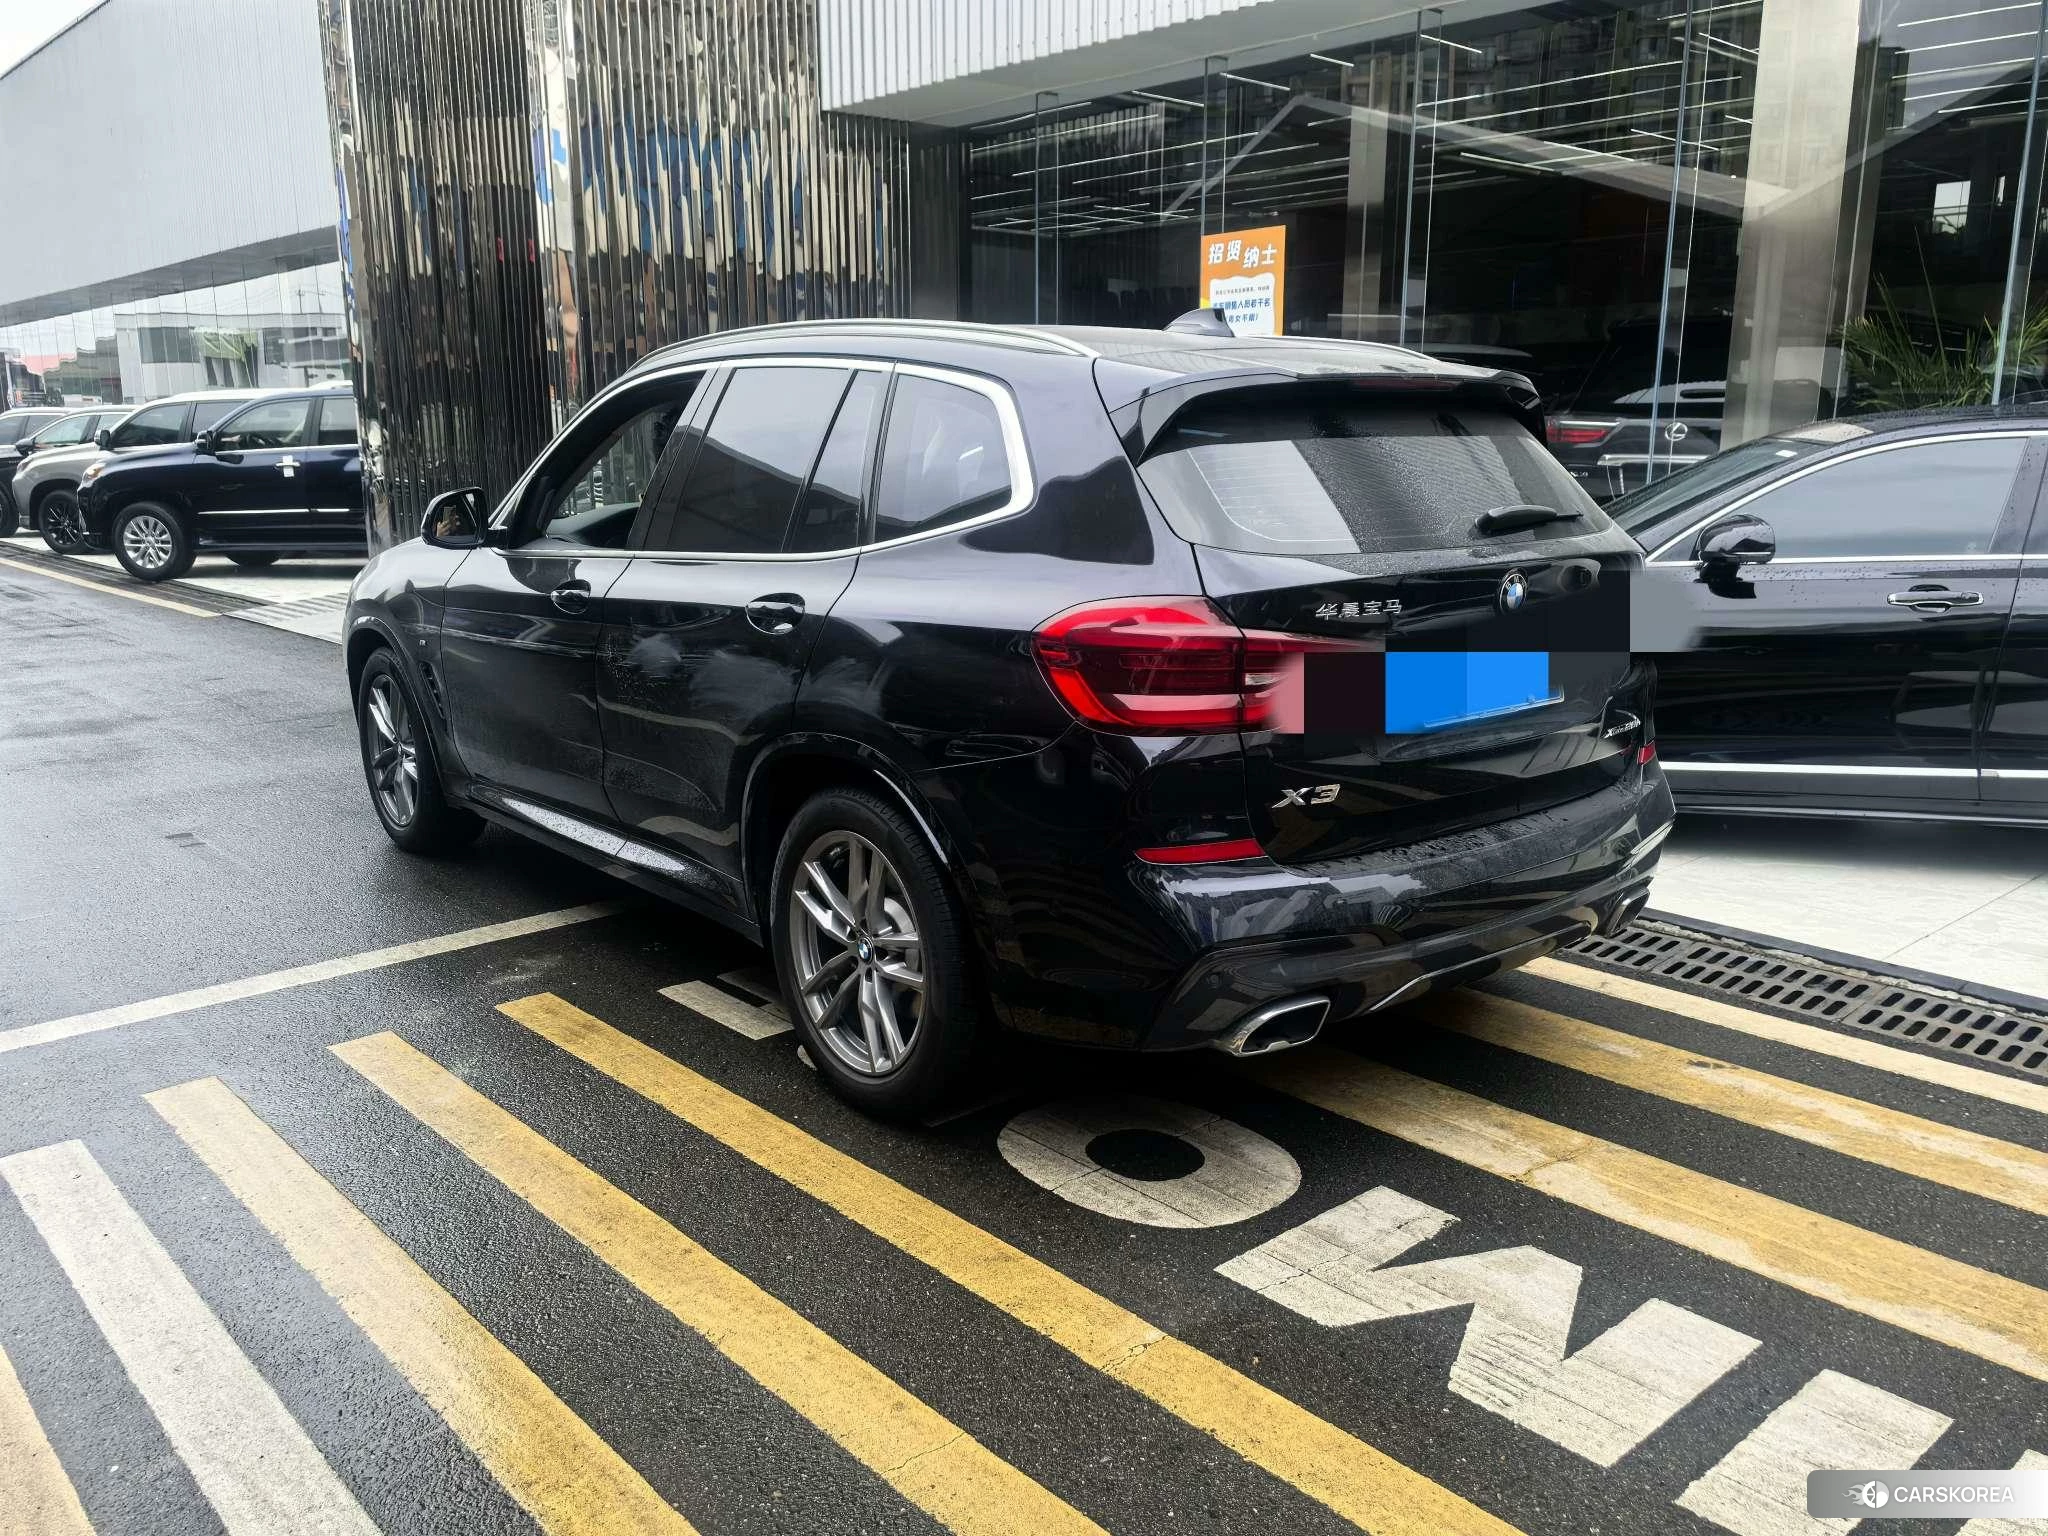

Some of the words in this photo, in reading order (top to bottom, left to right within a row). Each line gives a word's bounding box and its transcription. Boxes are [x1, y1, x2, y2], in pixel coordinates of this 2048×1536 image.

[1208, 239, 1278, 269] 招贤纳士
[1315, 599, 1402, 621] 华晨宝马
[1271, 783, 1341, 809] X3
